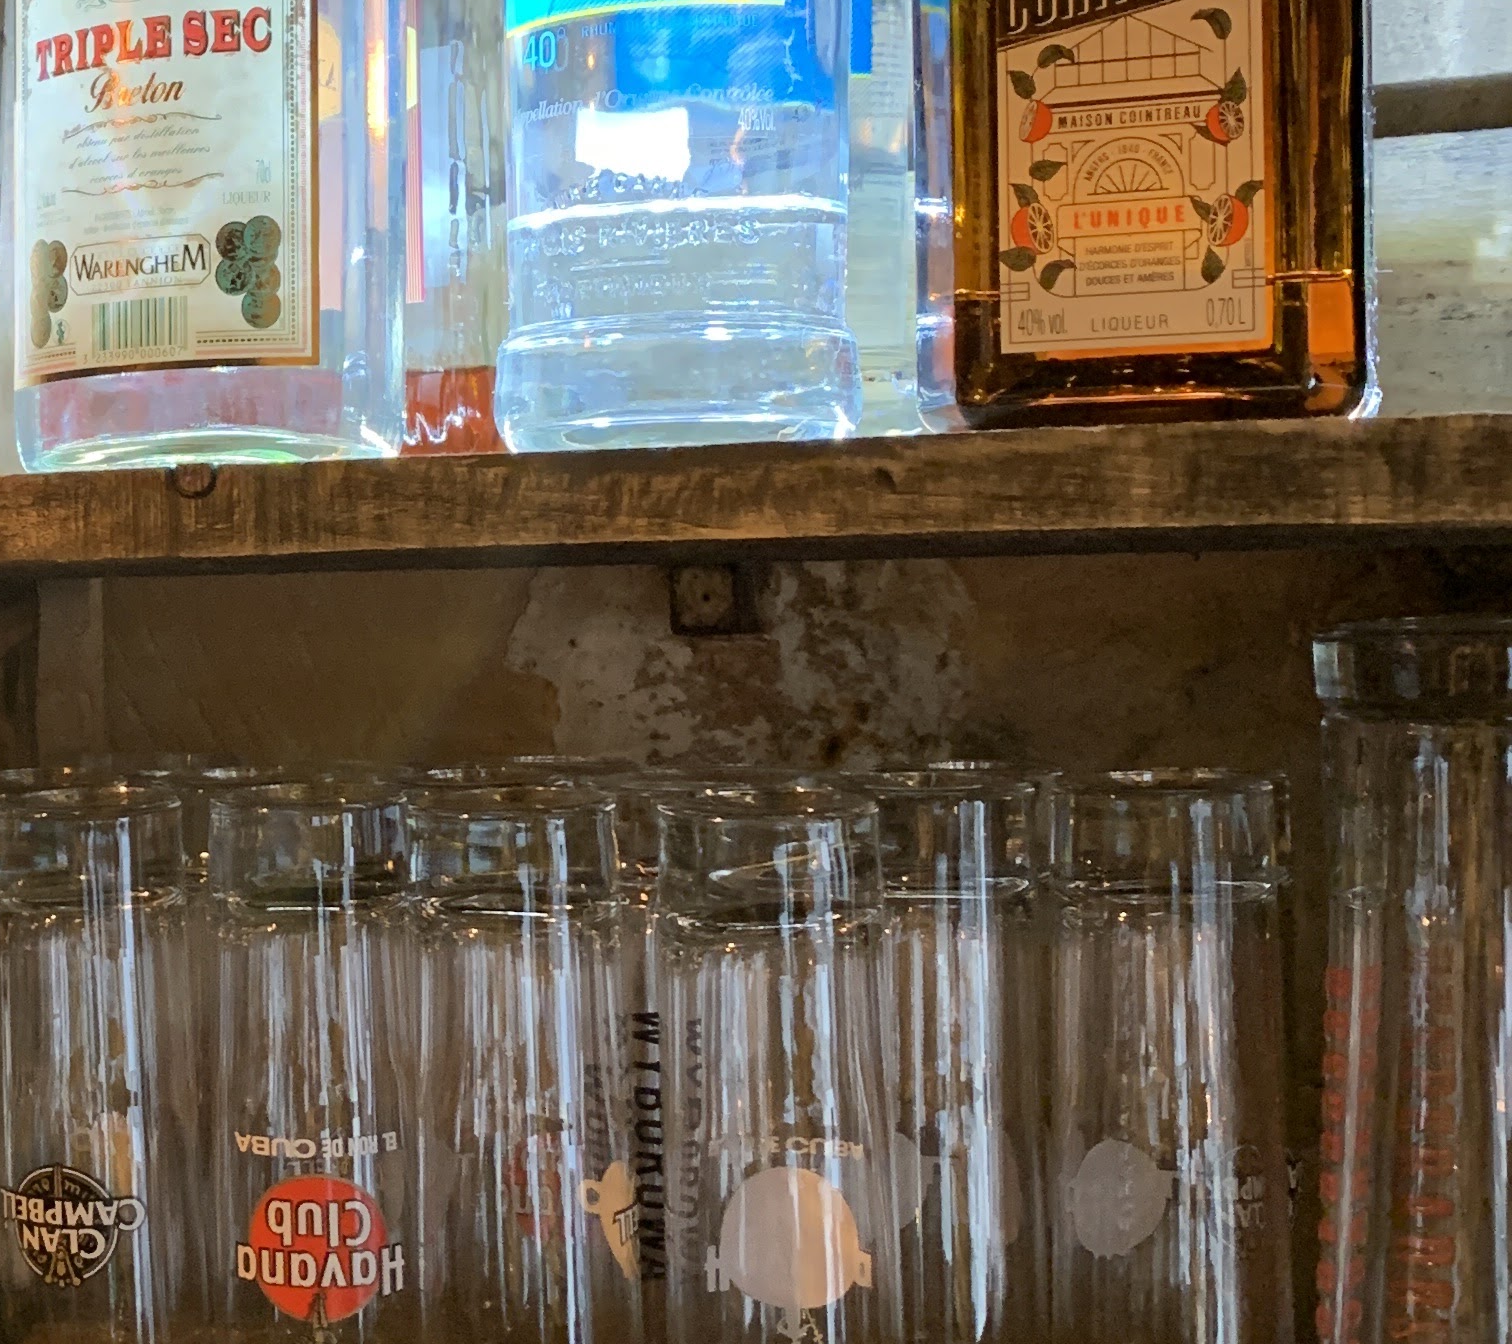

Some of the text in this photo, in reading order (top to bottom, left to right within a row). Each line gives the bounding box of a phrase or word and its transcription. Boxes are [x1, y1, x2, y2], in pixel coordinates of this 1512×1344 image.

[35, 6, 273, 83] TRIPLE SEC
[84, 68, 186, 115] Breton
[1058, 105, 1202, 131] MAISON COINTREAU
[222, 191, 272, 206] LIQUEUR
[1073, 204, 1187, 231] L'UNIQUE
[74, 243, 207, 283] WARENGHEM
[1085, 273, 1122, 287] DOUCES
[1123, 272, 1137, 285] ET
[1090, 313, 1170, 334] LIQUEUR
[234, 1131, 398, 1160] EL RON DE CUBA
[0, 1187, 147, 1233] CAMPBELL
[267, 1198, 373, 1249] Club
[23, 1220, 106, 1261] CLAN
[236, 1240, 405, 1297] Havana
